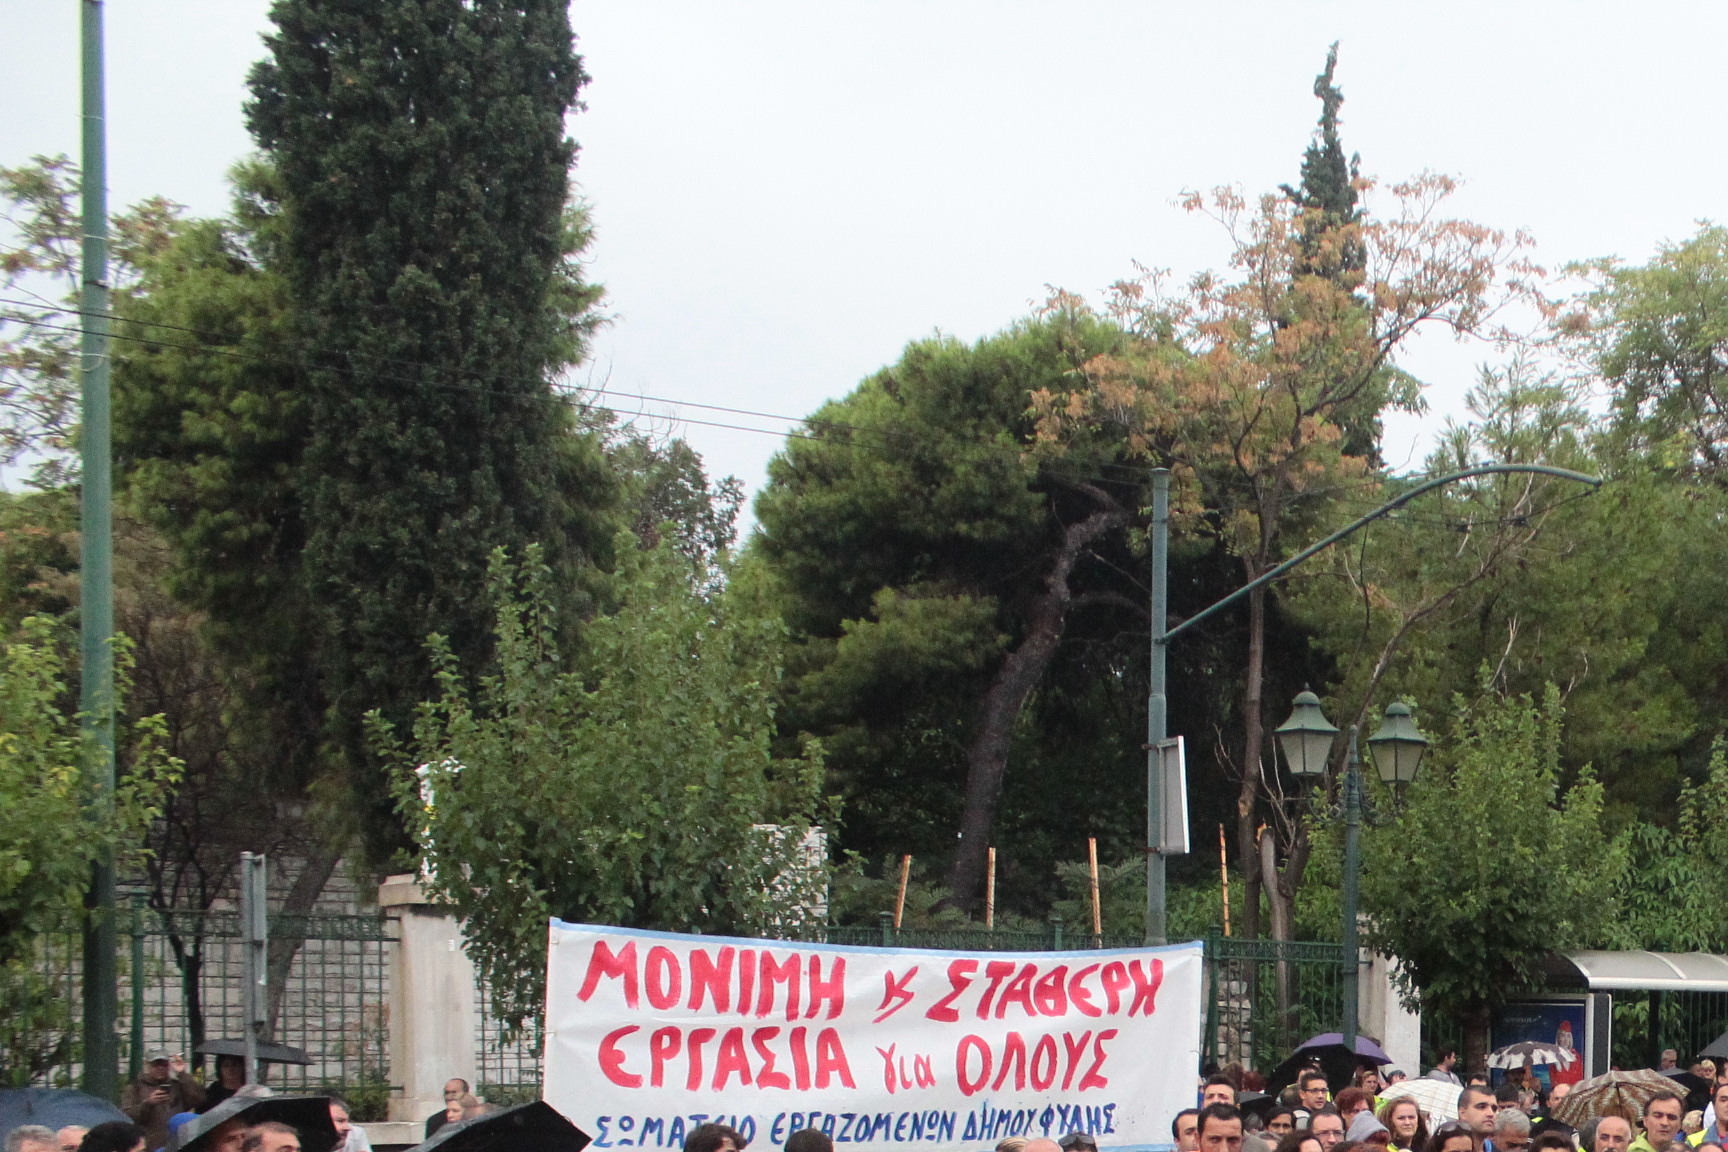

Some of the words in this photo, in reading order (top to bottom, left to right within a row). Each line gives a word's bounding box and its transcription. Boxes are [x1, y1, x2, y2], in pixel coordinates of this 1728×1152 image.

[577, 939, 846, 1022] ΜΟΝΙΜΗ
[926, 958, 1163, 1022] ΣΤΑΘΕΡΗ
[599, 1025, 856, 1091] ΕΡΓΑΣΙΑ
[875, 1042, 936, 1095] για
[956, 1028, 1119, 1097] ΟΛΟΥΣ
